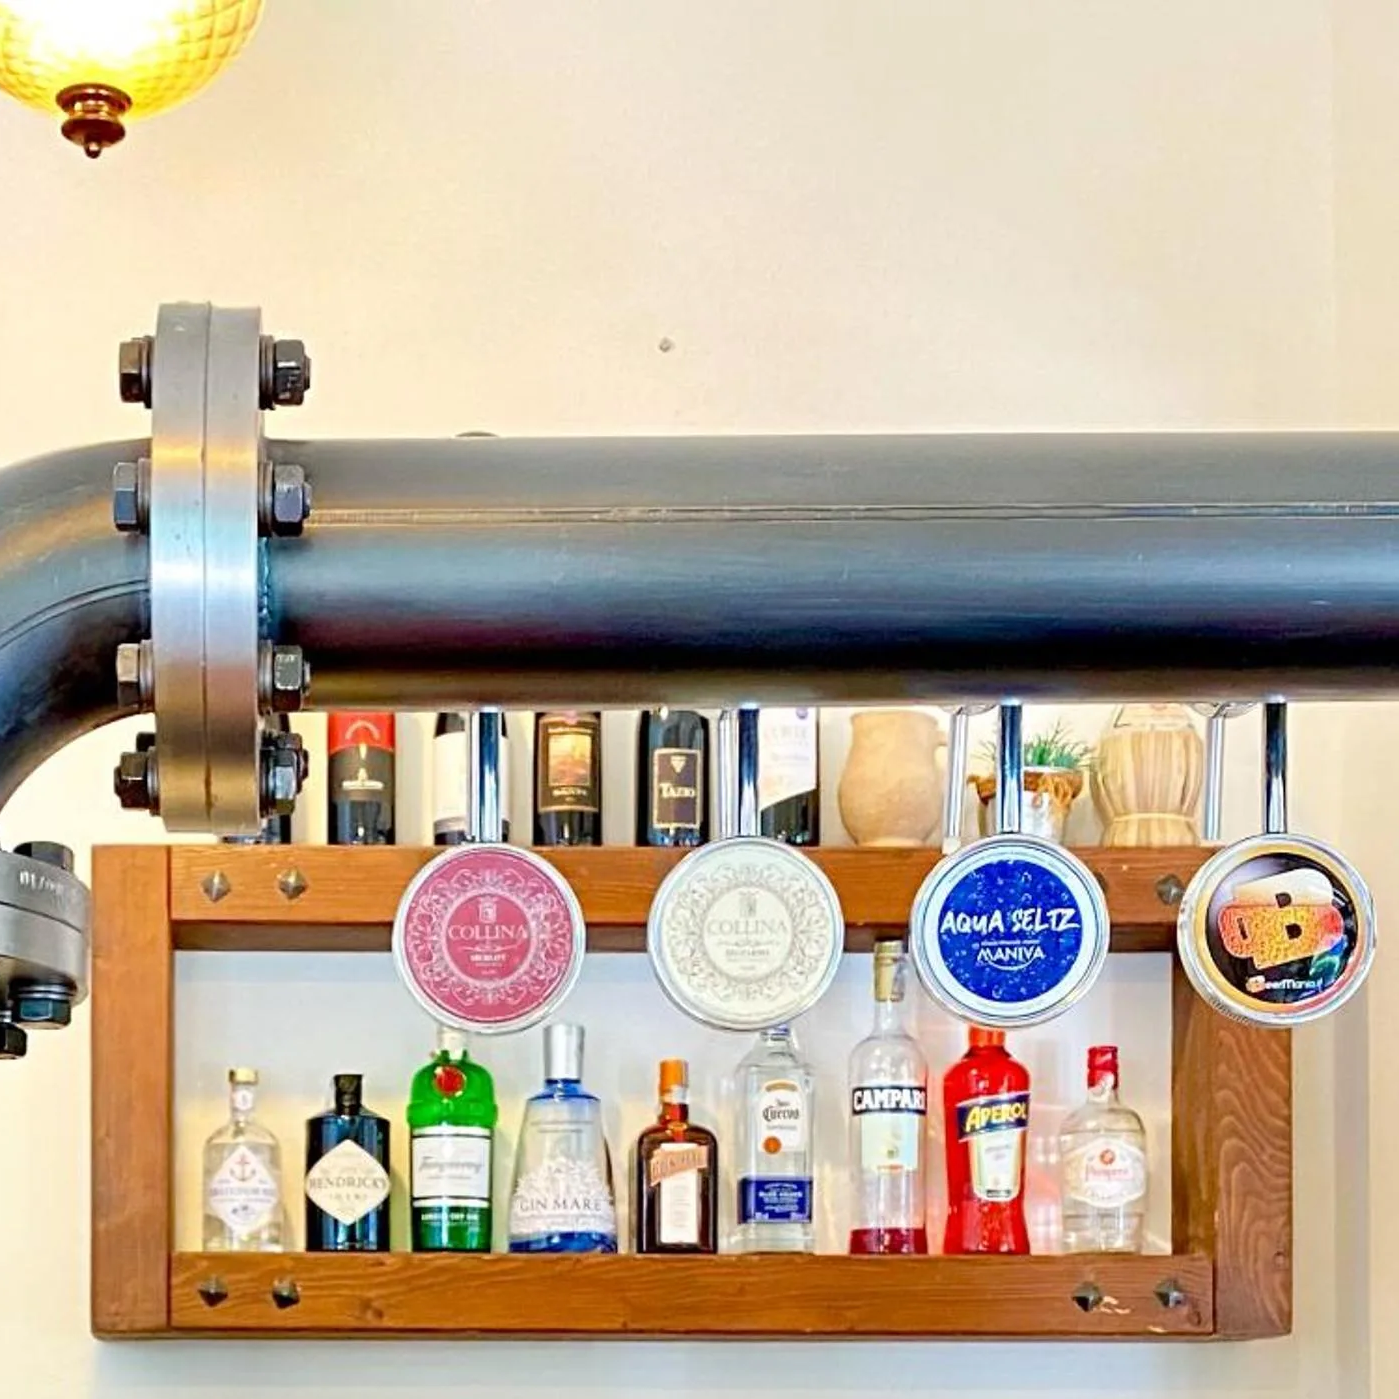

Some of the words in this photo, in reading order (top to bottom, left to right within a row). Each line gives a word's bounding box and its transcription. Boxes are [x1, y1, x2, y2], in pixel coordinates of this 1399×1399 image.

[707, 918, 789, 935] COLLINA
[940, 909, 1005, 935] AQUA
[1011, 906, 1081, 933] SELTZ
[448, 925, 528, 940] COLLINA
[976, 945, 1047, 963] MANIVA
[519, 1198, 550, 1213] GIN
[554, 1197, 603, 1212] MARE
